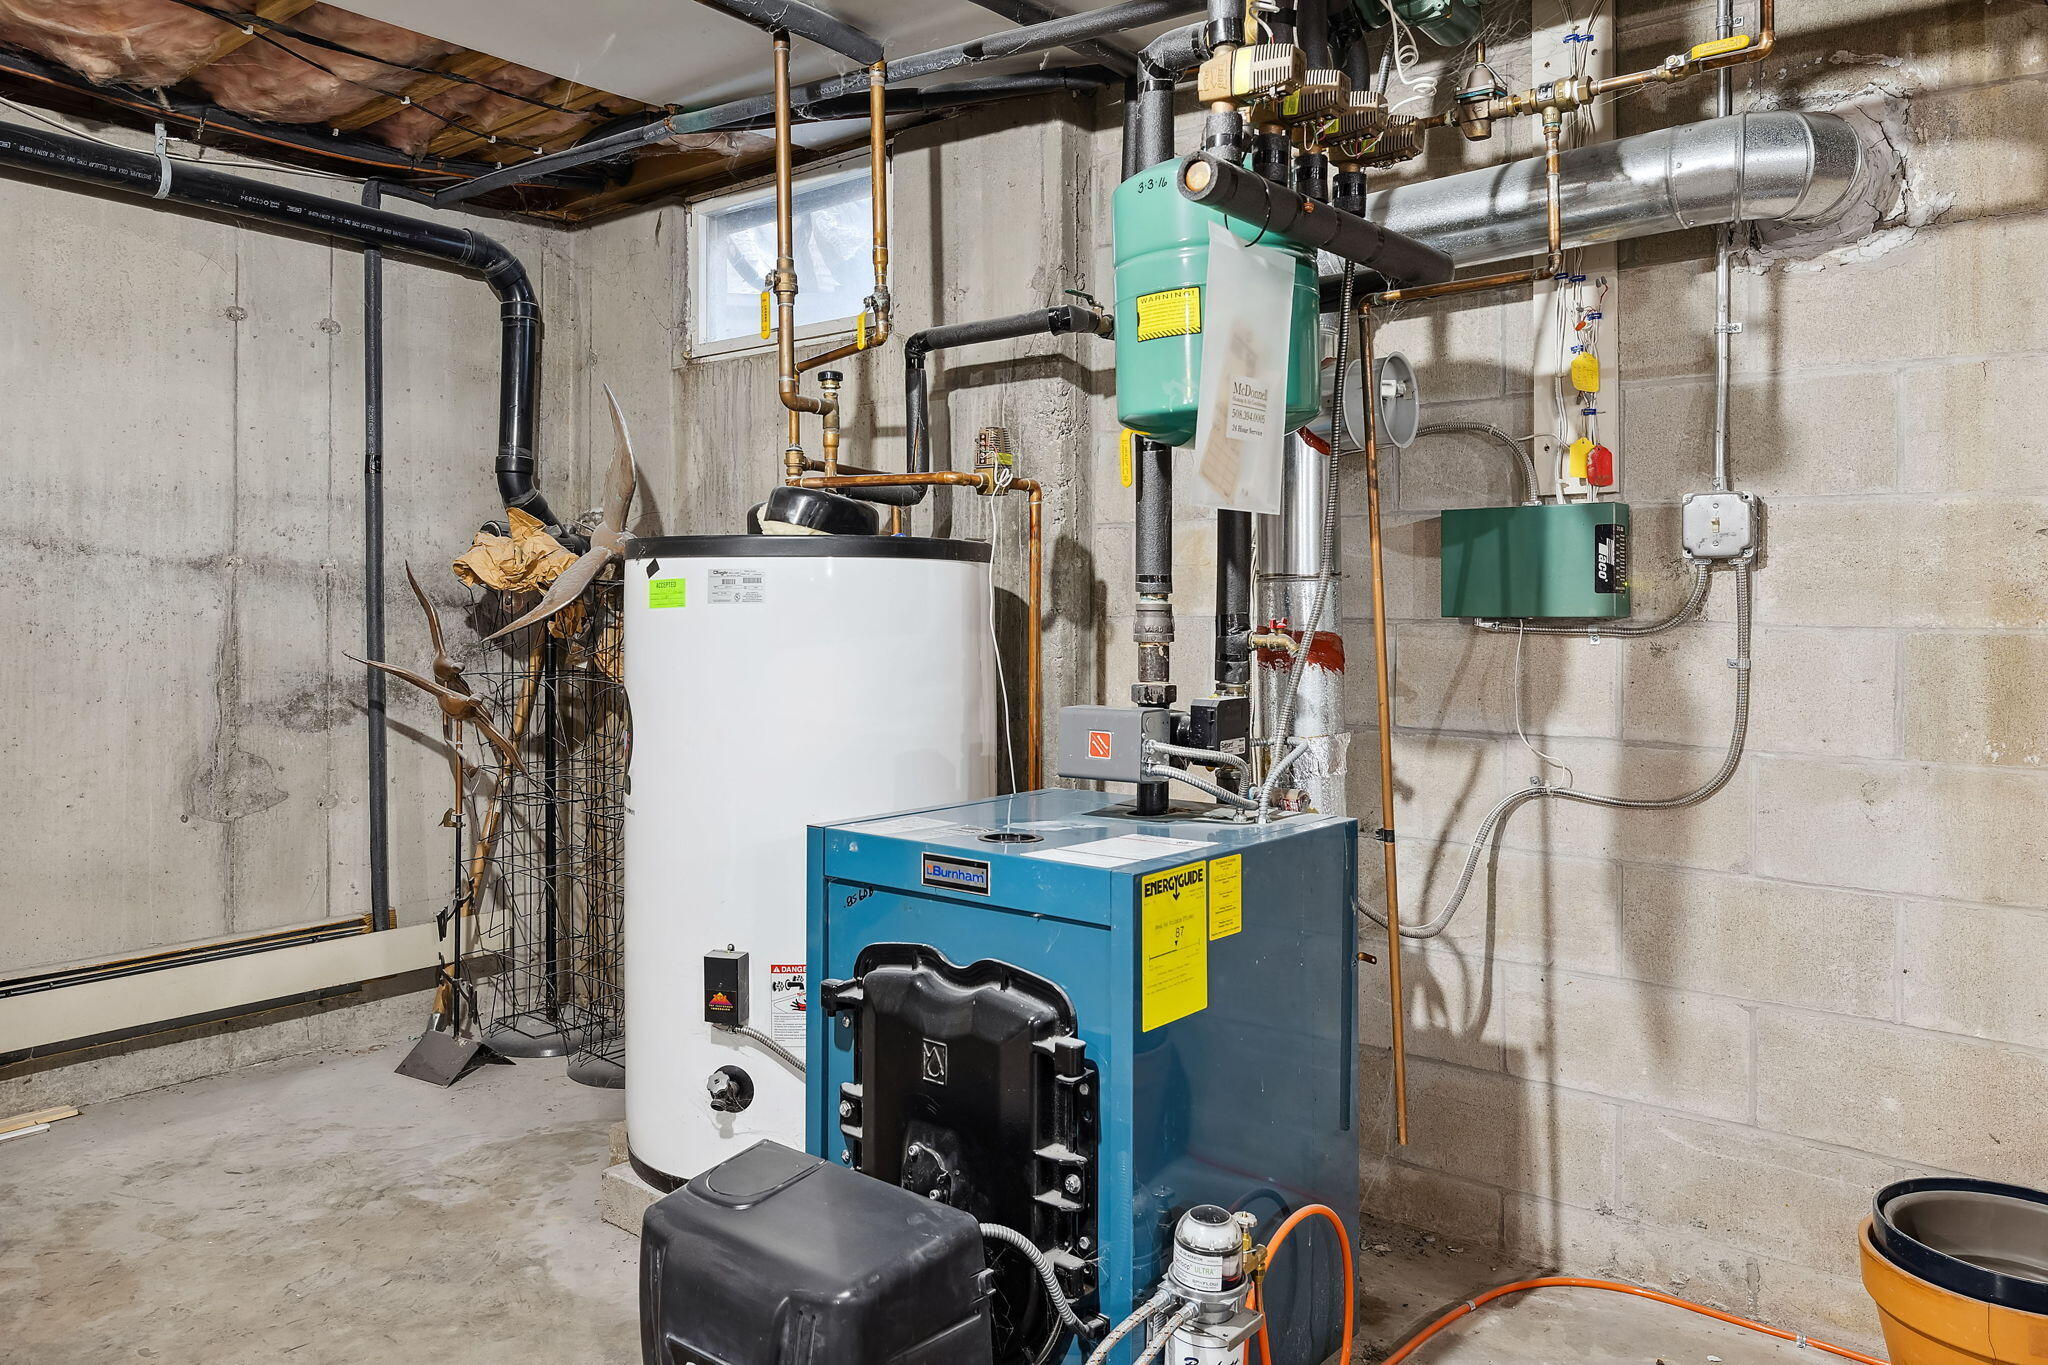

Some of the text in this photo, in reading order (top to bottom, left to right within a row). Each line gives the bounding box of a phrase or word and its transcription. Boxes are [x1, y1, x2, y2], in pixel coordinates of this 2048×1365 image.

[1140, 289, 1196, 305] WARNING!
[1598, 538, 1615, 580] Taco
[933, 865, 985, 884] Burnham
[1144, 868, 1204, 898] ENERGYGUIDE
[1194, 1265, 1215, 1277] ULTRA
